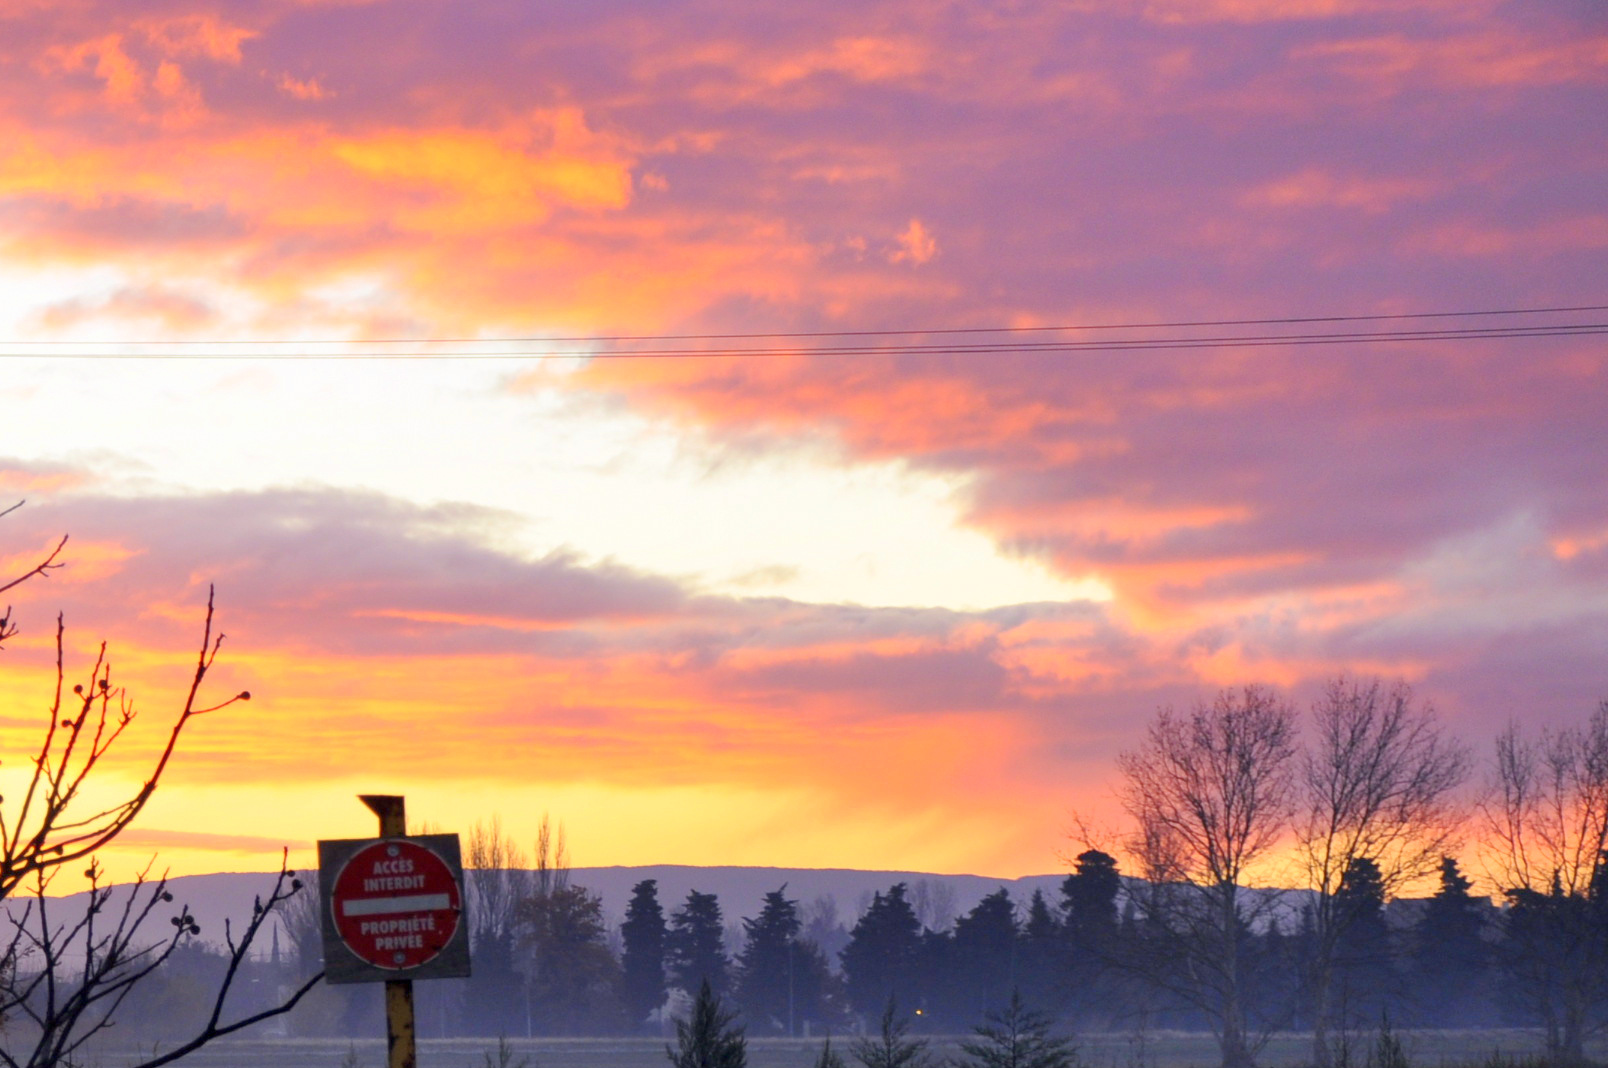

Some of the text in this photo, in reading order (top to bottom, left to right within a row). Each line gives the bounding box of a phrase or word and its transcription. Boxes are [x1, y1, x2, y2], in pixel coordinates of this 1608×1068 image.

[374, 857, 413, 874] ACCÈS
[364, 875, 425, 892] INTERDIT
[361, 915, 435, 935] PROPRIÉTÉ
[375, 932, 423, 950] PRIVÉE
